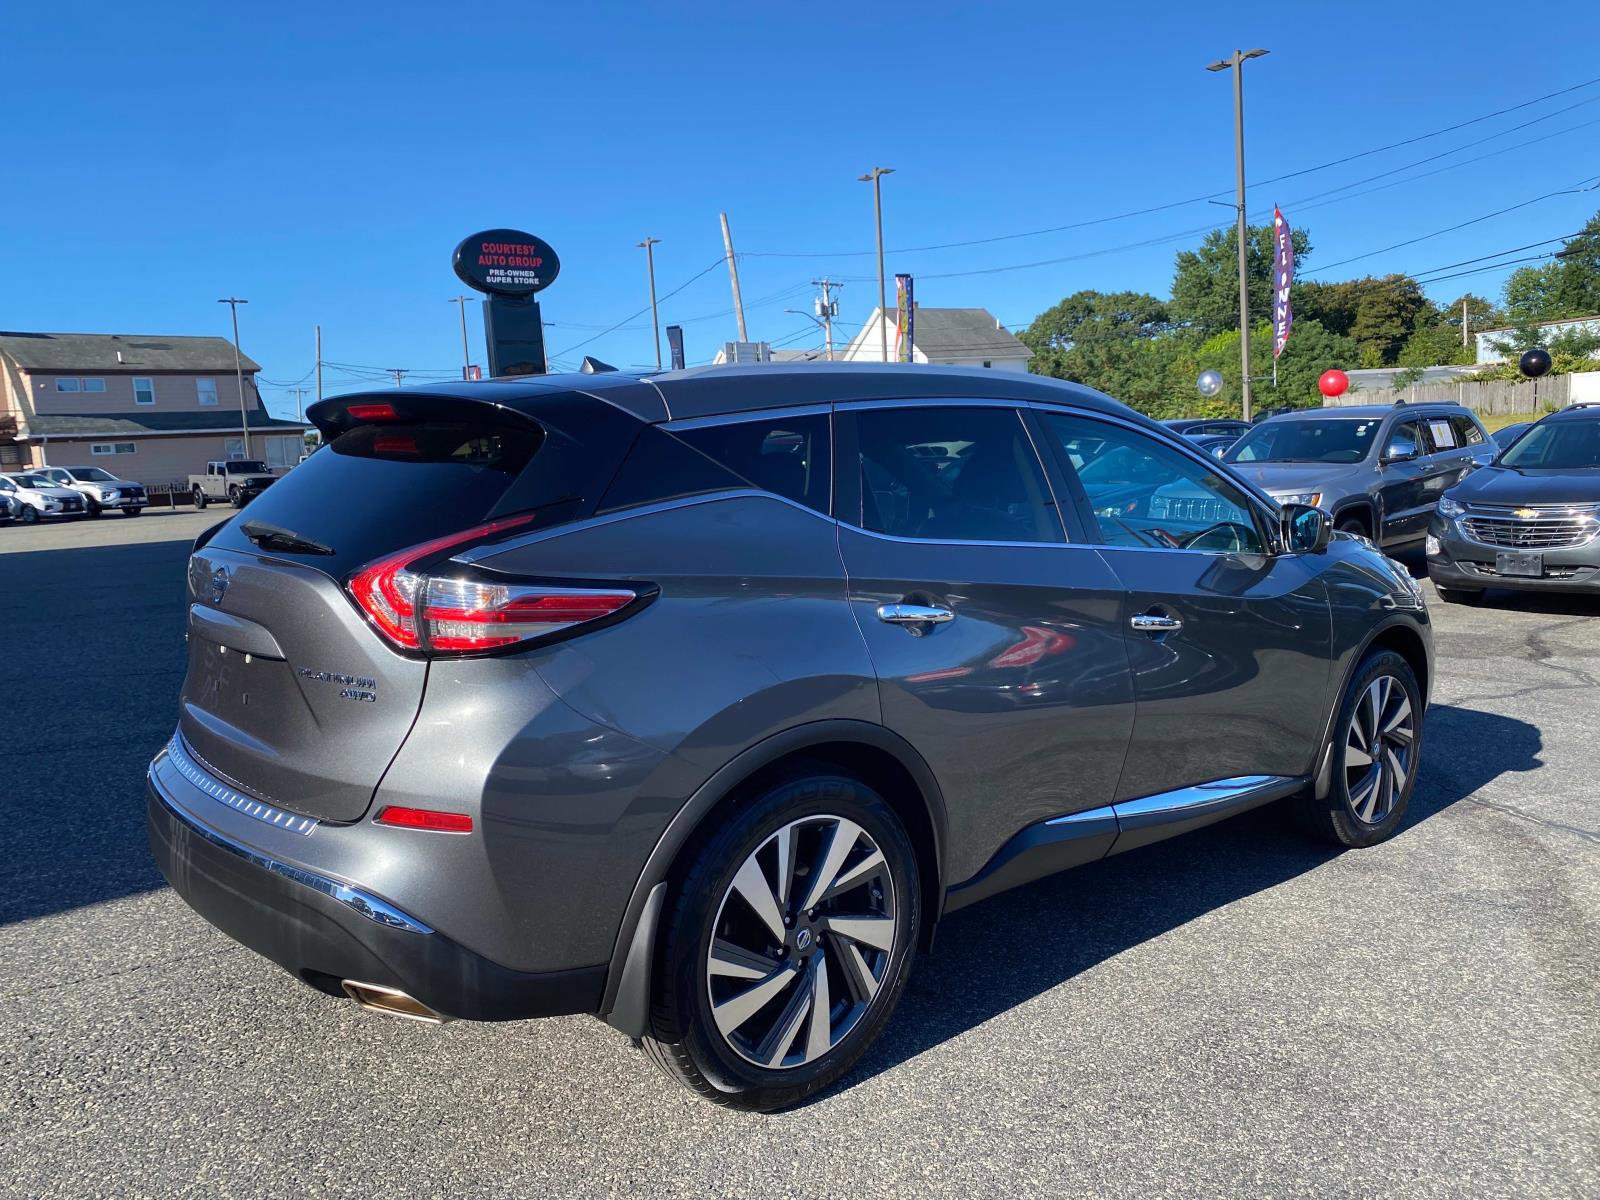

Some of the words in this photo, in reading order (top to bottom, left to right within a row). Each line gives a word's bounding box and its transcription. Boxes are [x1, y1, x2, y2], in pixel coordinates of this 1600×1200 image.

[482, 243, 535, 255] COURTESY
[479, 255, 506, 266] AUTO
[508, 256, 543, 267] GROUP
[489, 268, 535, 277] PRE-OWNED
[486, 276, 513, 284] SUPER
[513, 277, 540, 285] STORE
